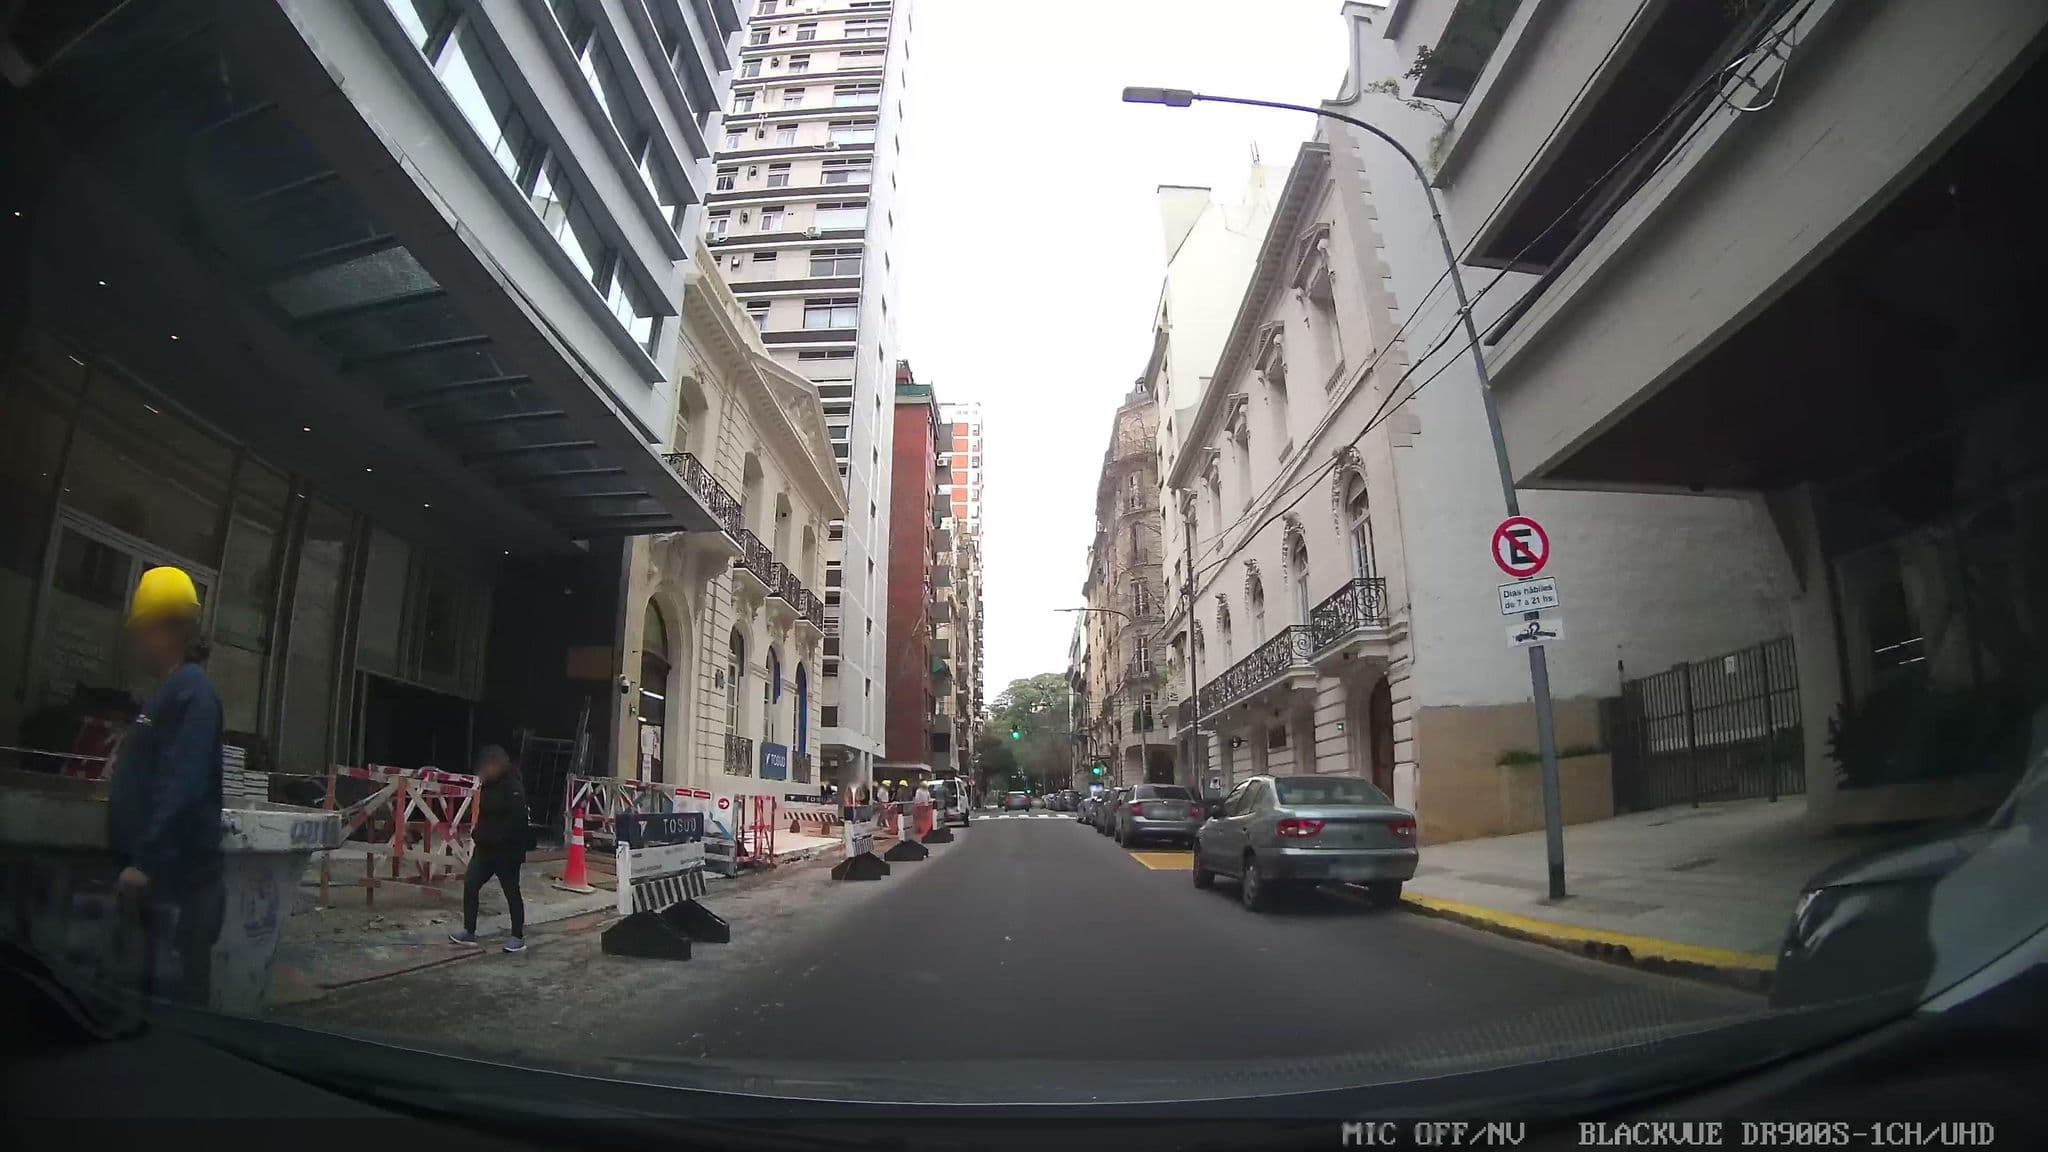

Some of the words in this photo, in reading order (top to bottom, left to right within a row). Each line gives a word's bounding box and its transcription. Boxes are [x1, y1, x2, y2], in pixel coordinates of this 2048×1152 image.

[1532, 596, 1541, 604] 21
[770, 754, 786, 767] TOSUD
[663, 818, 697, 834] TOSUD
